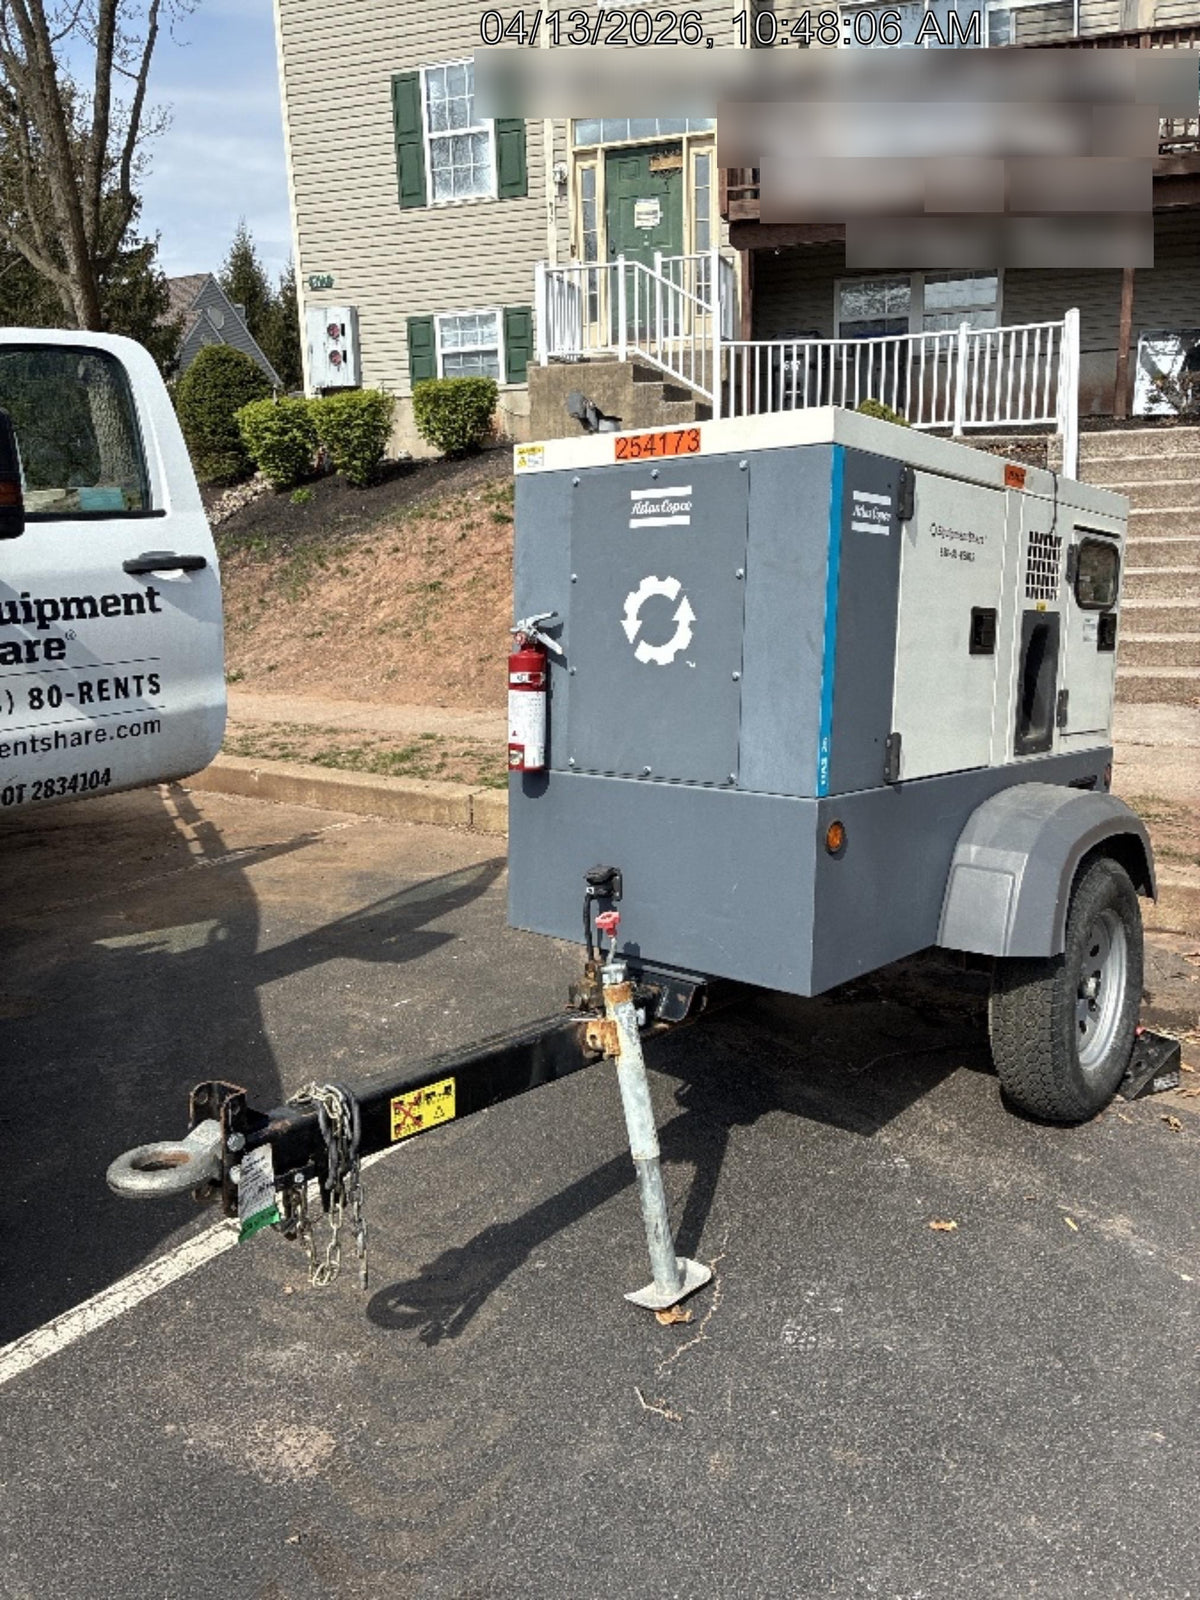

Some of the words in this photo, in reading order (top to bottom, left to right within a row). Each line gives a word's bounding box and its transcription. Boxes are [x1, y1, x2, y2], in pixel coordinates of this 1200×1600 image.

[615, 428, 700, 460] 254173
[0, 586, 162, 630] uipment
[28, 673, 161, 710] 80-RENTS
[0, 719, 161, 758] entshare.com
[31, 767, 112, 802] 2834104
